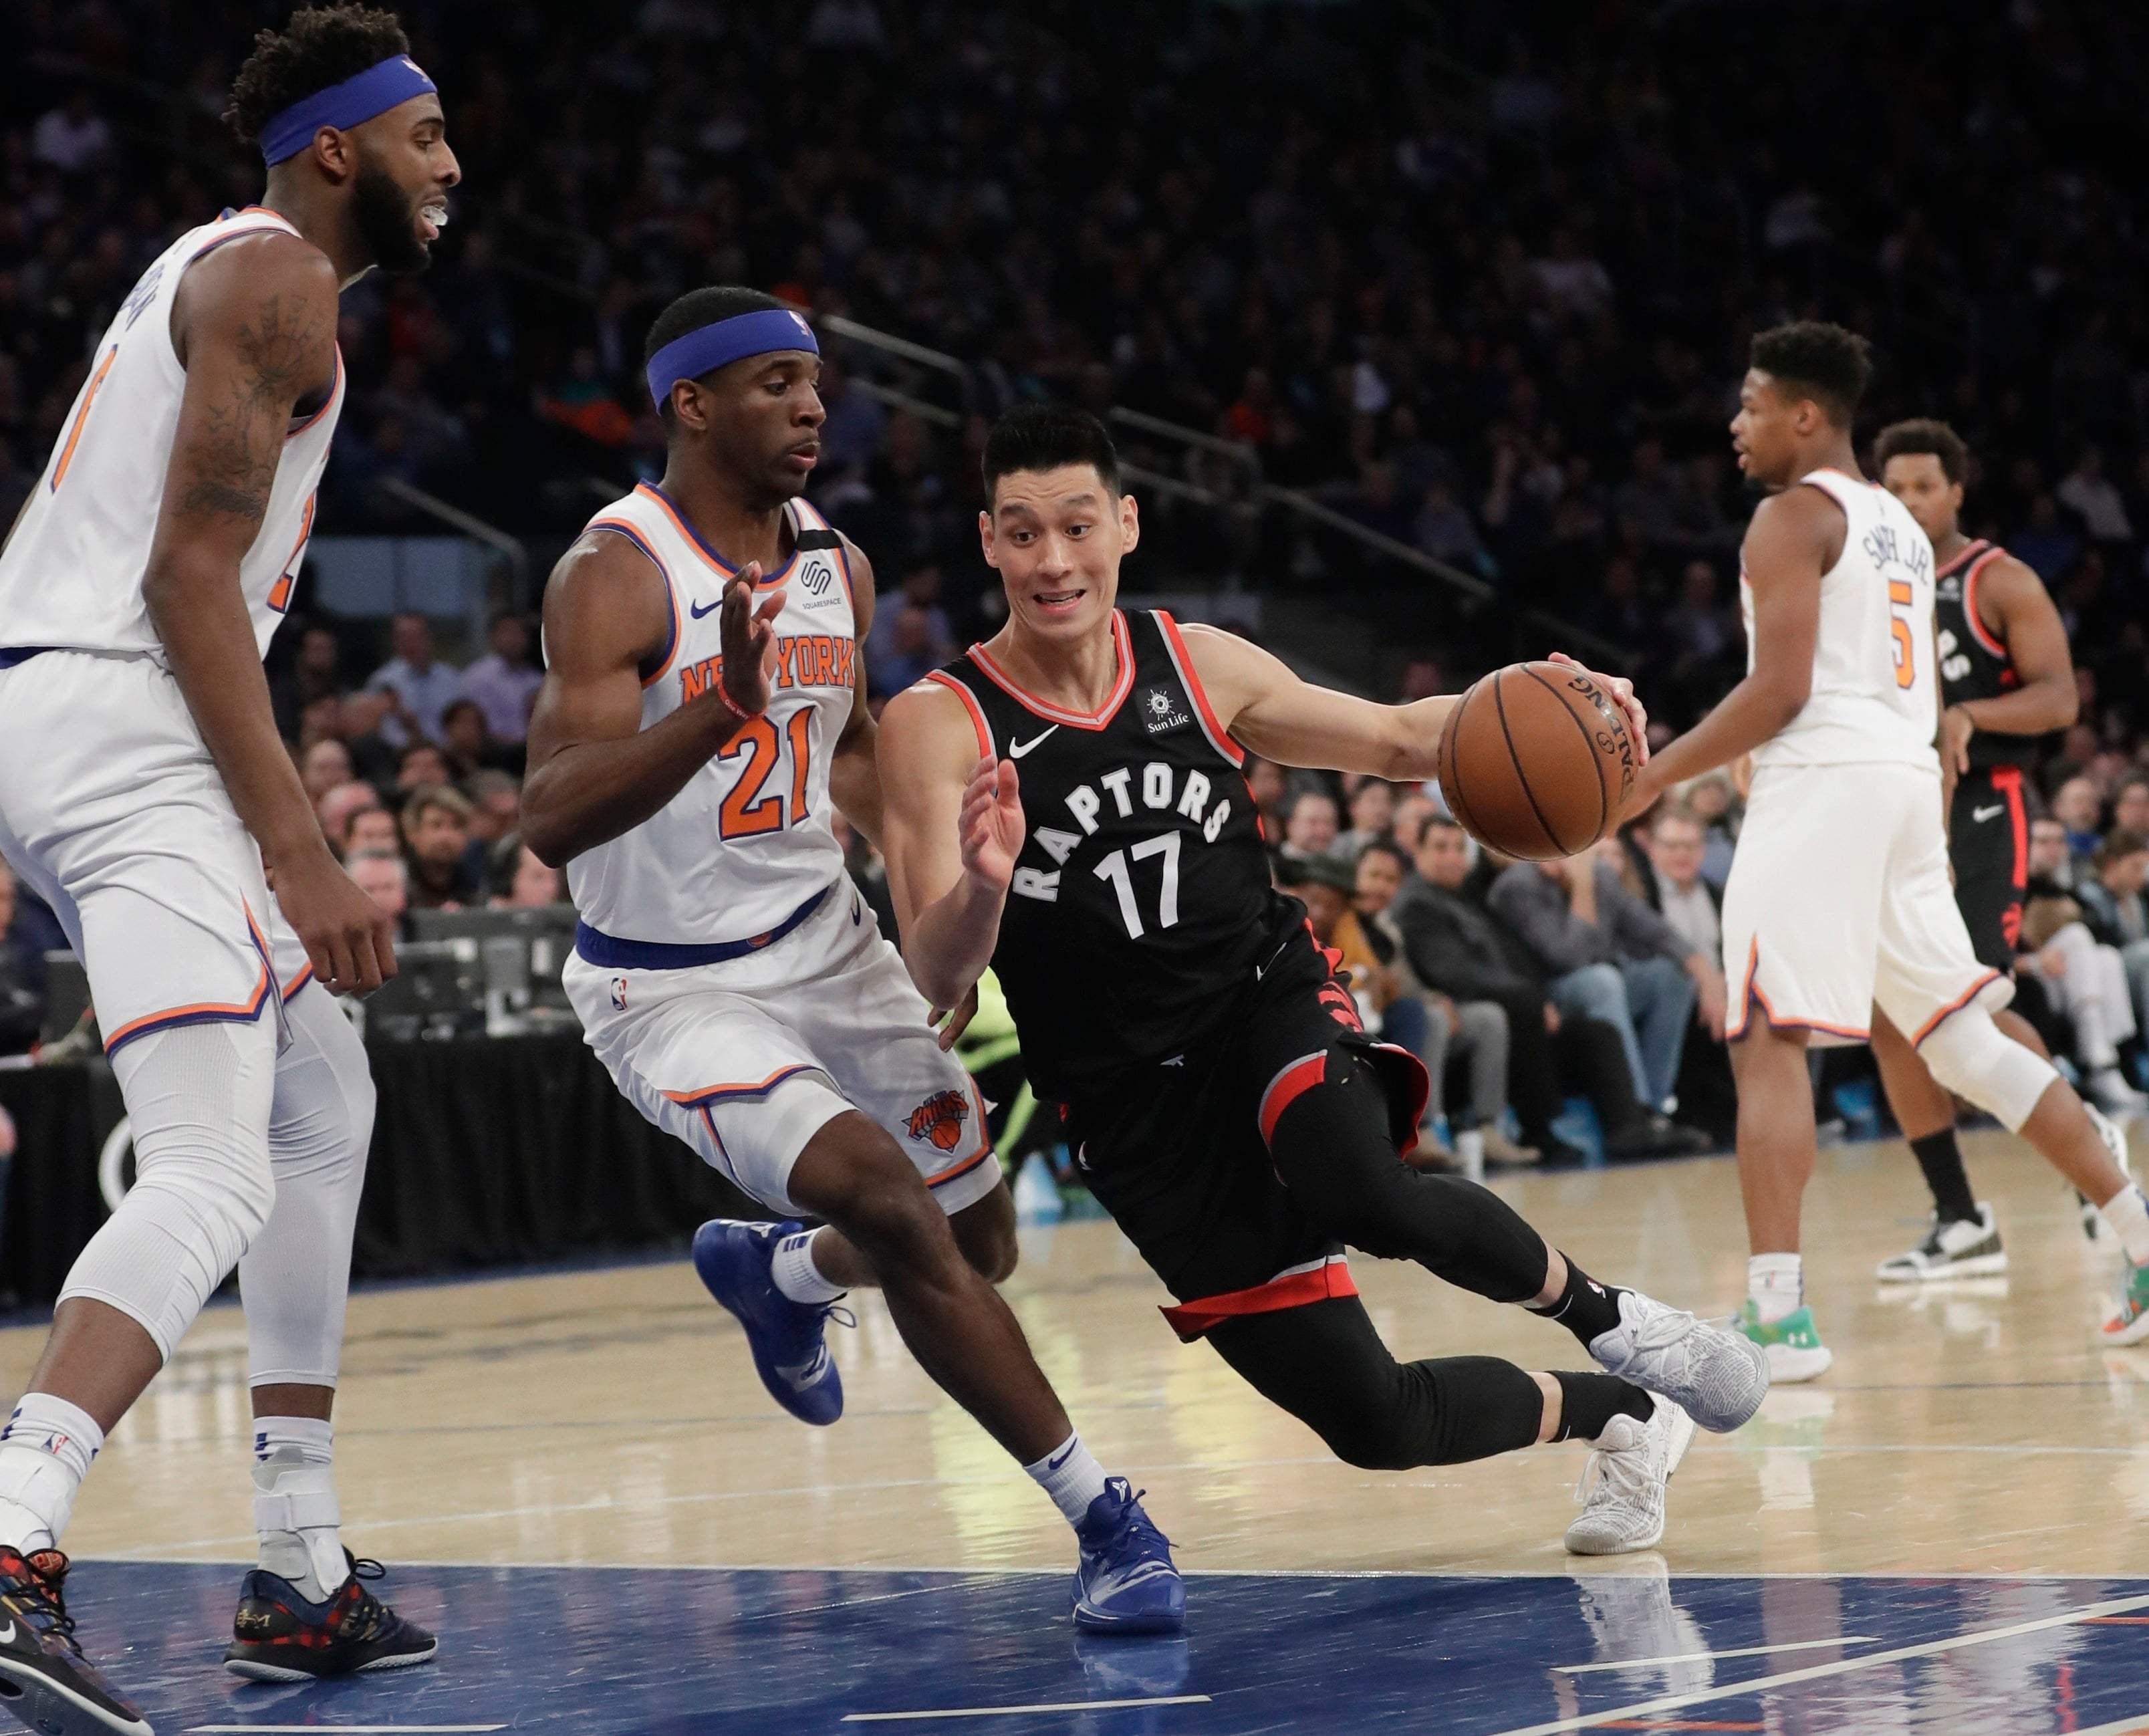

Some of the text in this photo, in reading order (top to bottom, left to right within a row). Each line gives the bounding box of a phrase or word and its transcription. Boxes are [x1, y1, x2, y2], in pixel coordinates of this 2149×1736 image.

[802, 598, 841, 610] SQUARESPACE
[1888, 578, 1915, 690] 5
[680, 636, 855, 705] NE YORK
[725, 699, 748, 720] One Way
[1148, 713, 1189, 733] Sun Life
[718, 706, 817, 842] 21
[1013, 762, 1231, 902] RAPTORS
[1092, 830, 1181, 940] 17
